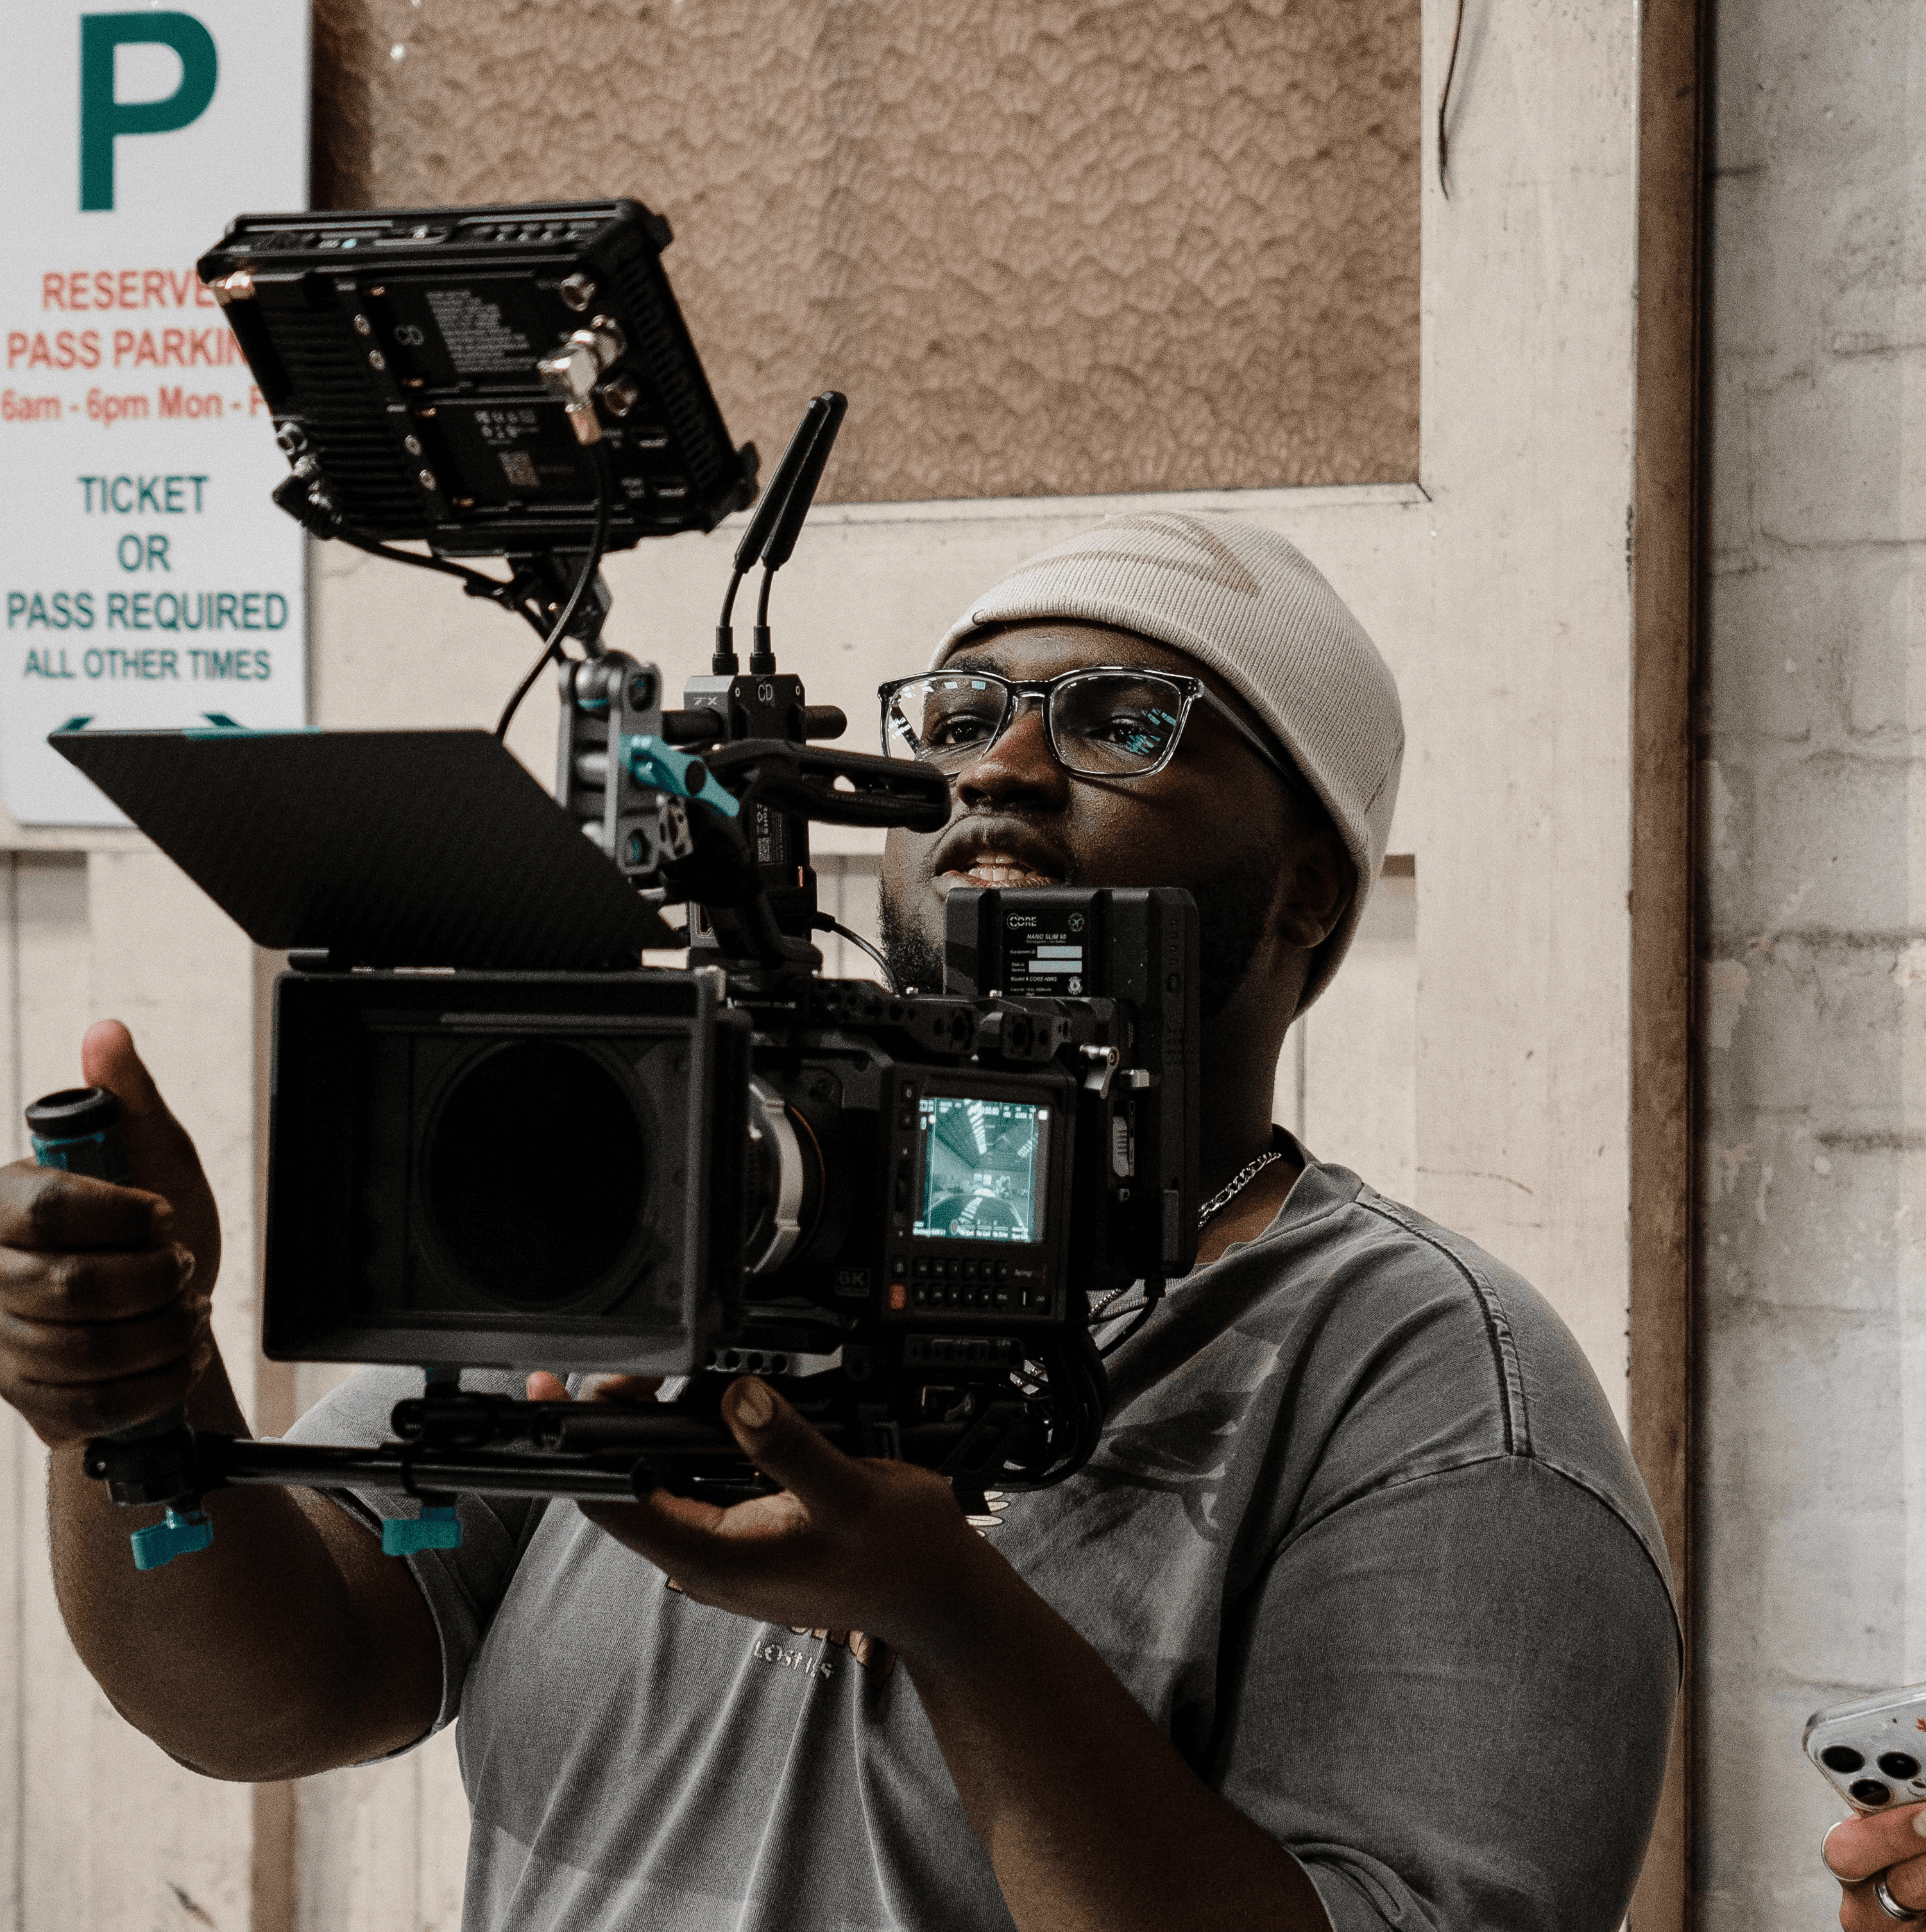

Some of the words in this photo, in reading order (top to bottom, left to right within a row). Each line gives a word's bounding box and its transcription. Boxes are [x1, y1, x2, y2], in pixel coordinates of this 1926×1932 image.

[79, 10, 218, 212] P
[7, 329, 102, 371] PASS
[1, 389, 62, 421] 6am
[85, 387, 149, 426] 6pm
[158, 386, 223, 419] Mon
[78, 475, 209, 513] TICKET
[118, 534, 170, 572] OR
[8, 593, 94, 629] PASS
[108, 593, 288, 631] REQUIRED
[25, 650, 75, 678] ALL
[85, 649, 178, 679] OTHER
[188, 649, 271, 680] TIMES
[839, 1271, 865, 1286] 6K
